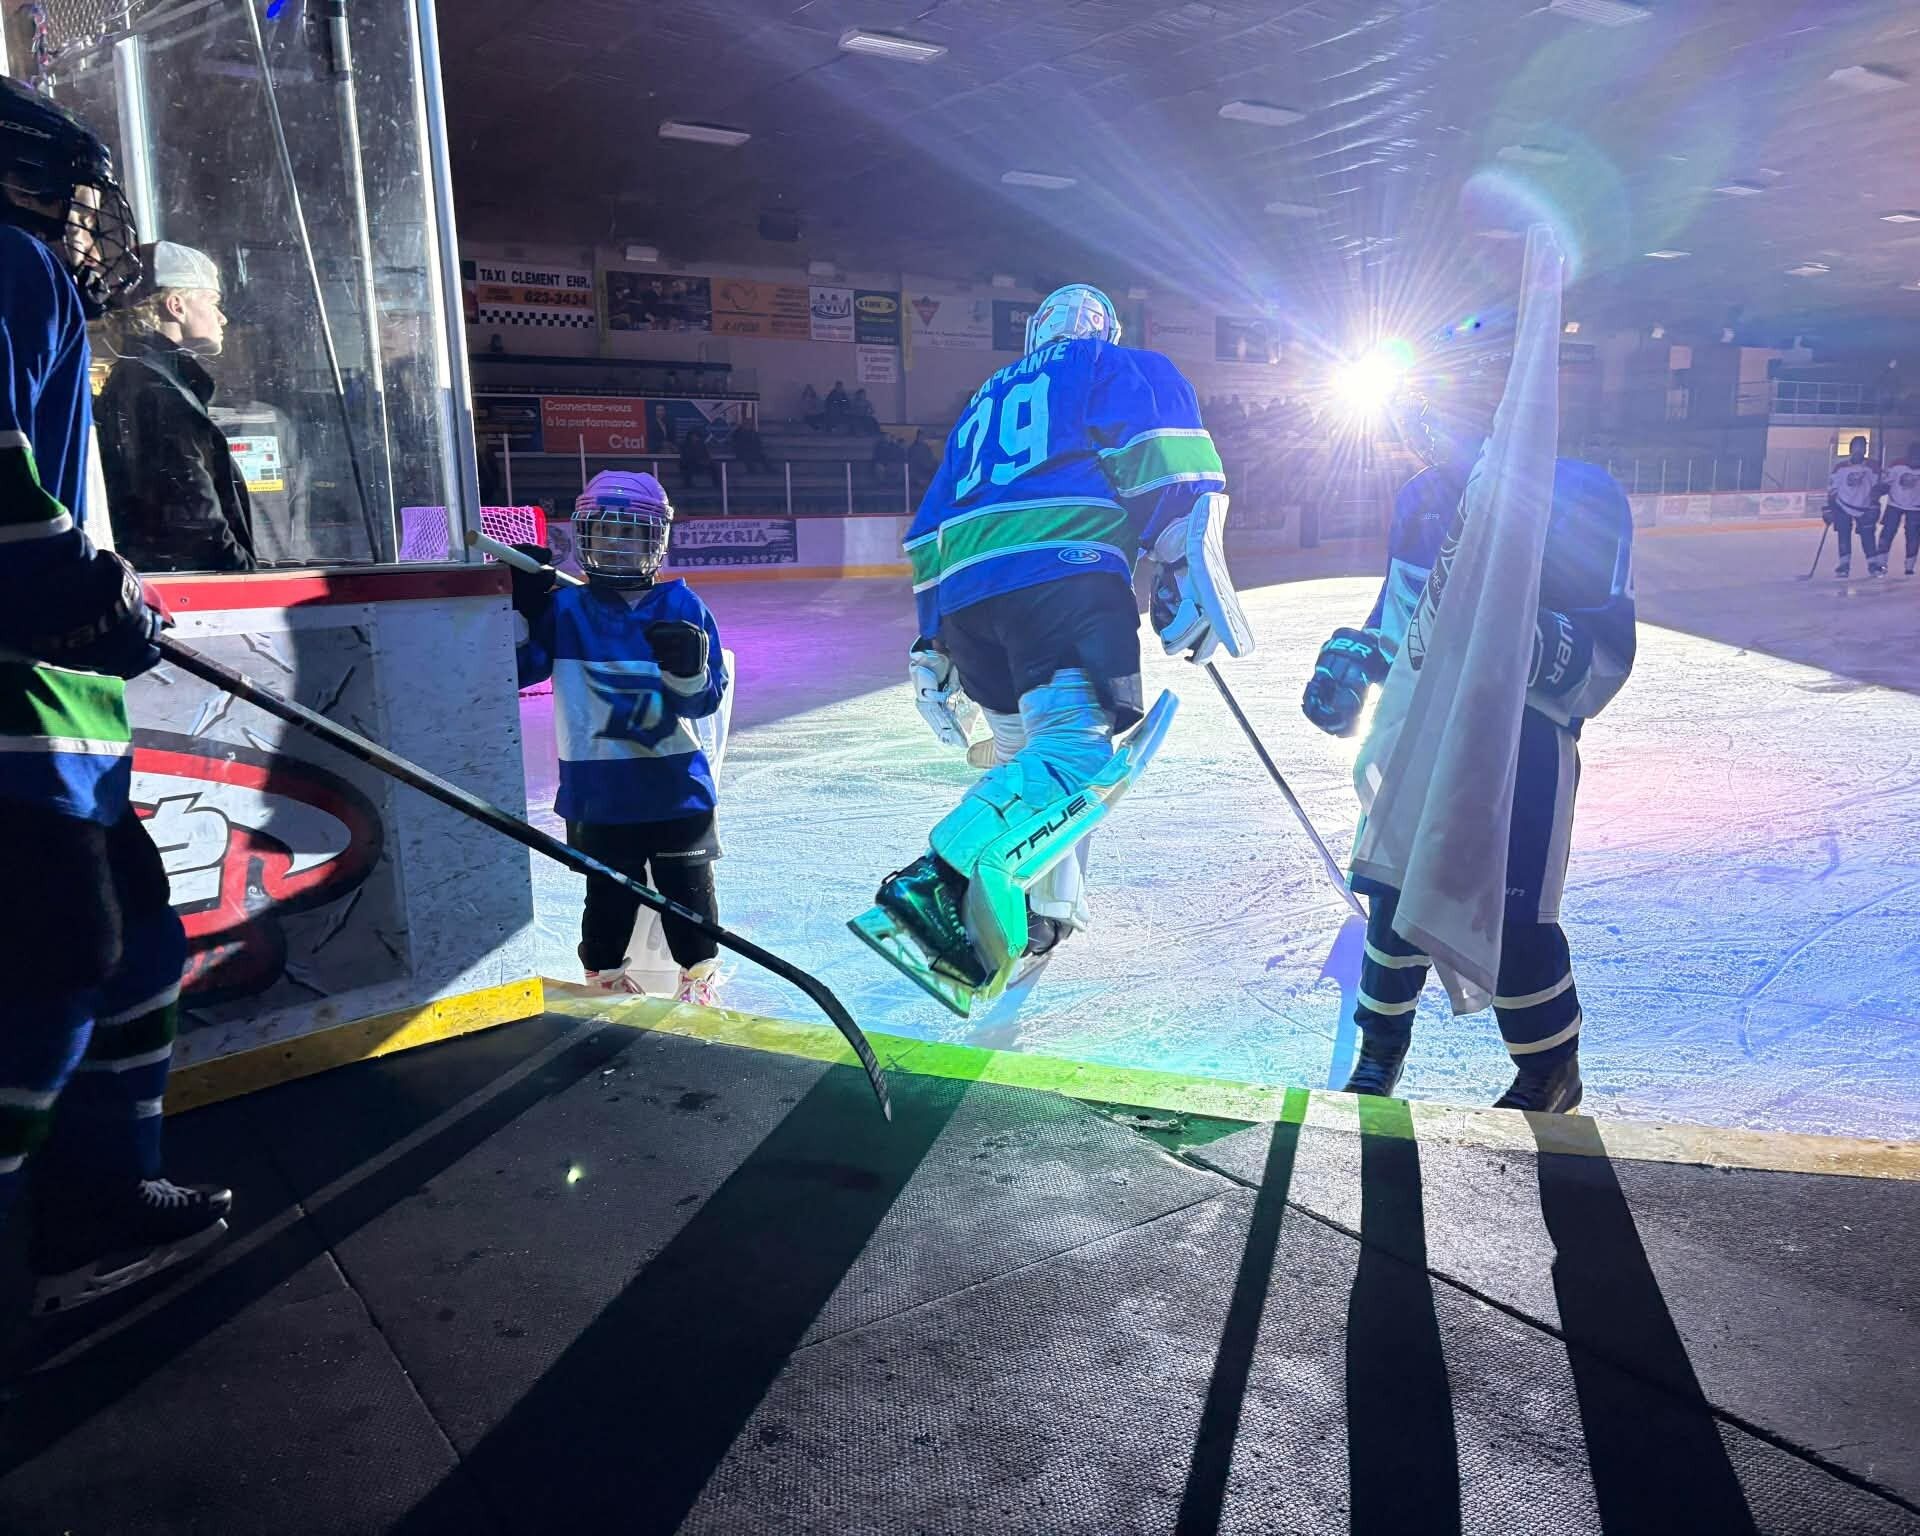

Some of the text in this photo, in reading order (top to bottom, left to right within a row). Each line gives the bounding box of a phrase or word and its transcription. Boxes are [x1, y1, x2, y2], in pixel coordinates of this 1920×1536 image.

[480, 269, 506, 282] TAXI
[511, 271, 560, 286] CLEMENT
[970, 340, 1069, 408] LAPLANTE
[545, 400, 632, 413] Connectez-vous
[955, 372, 1051, 501] 29
[680, 529, 768, 545] PIZZERIA
[1005, 794, 1088, 861] TRUE
